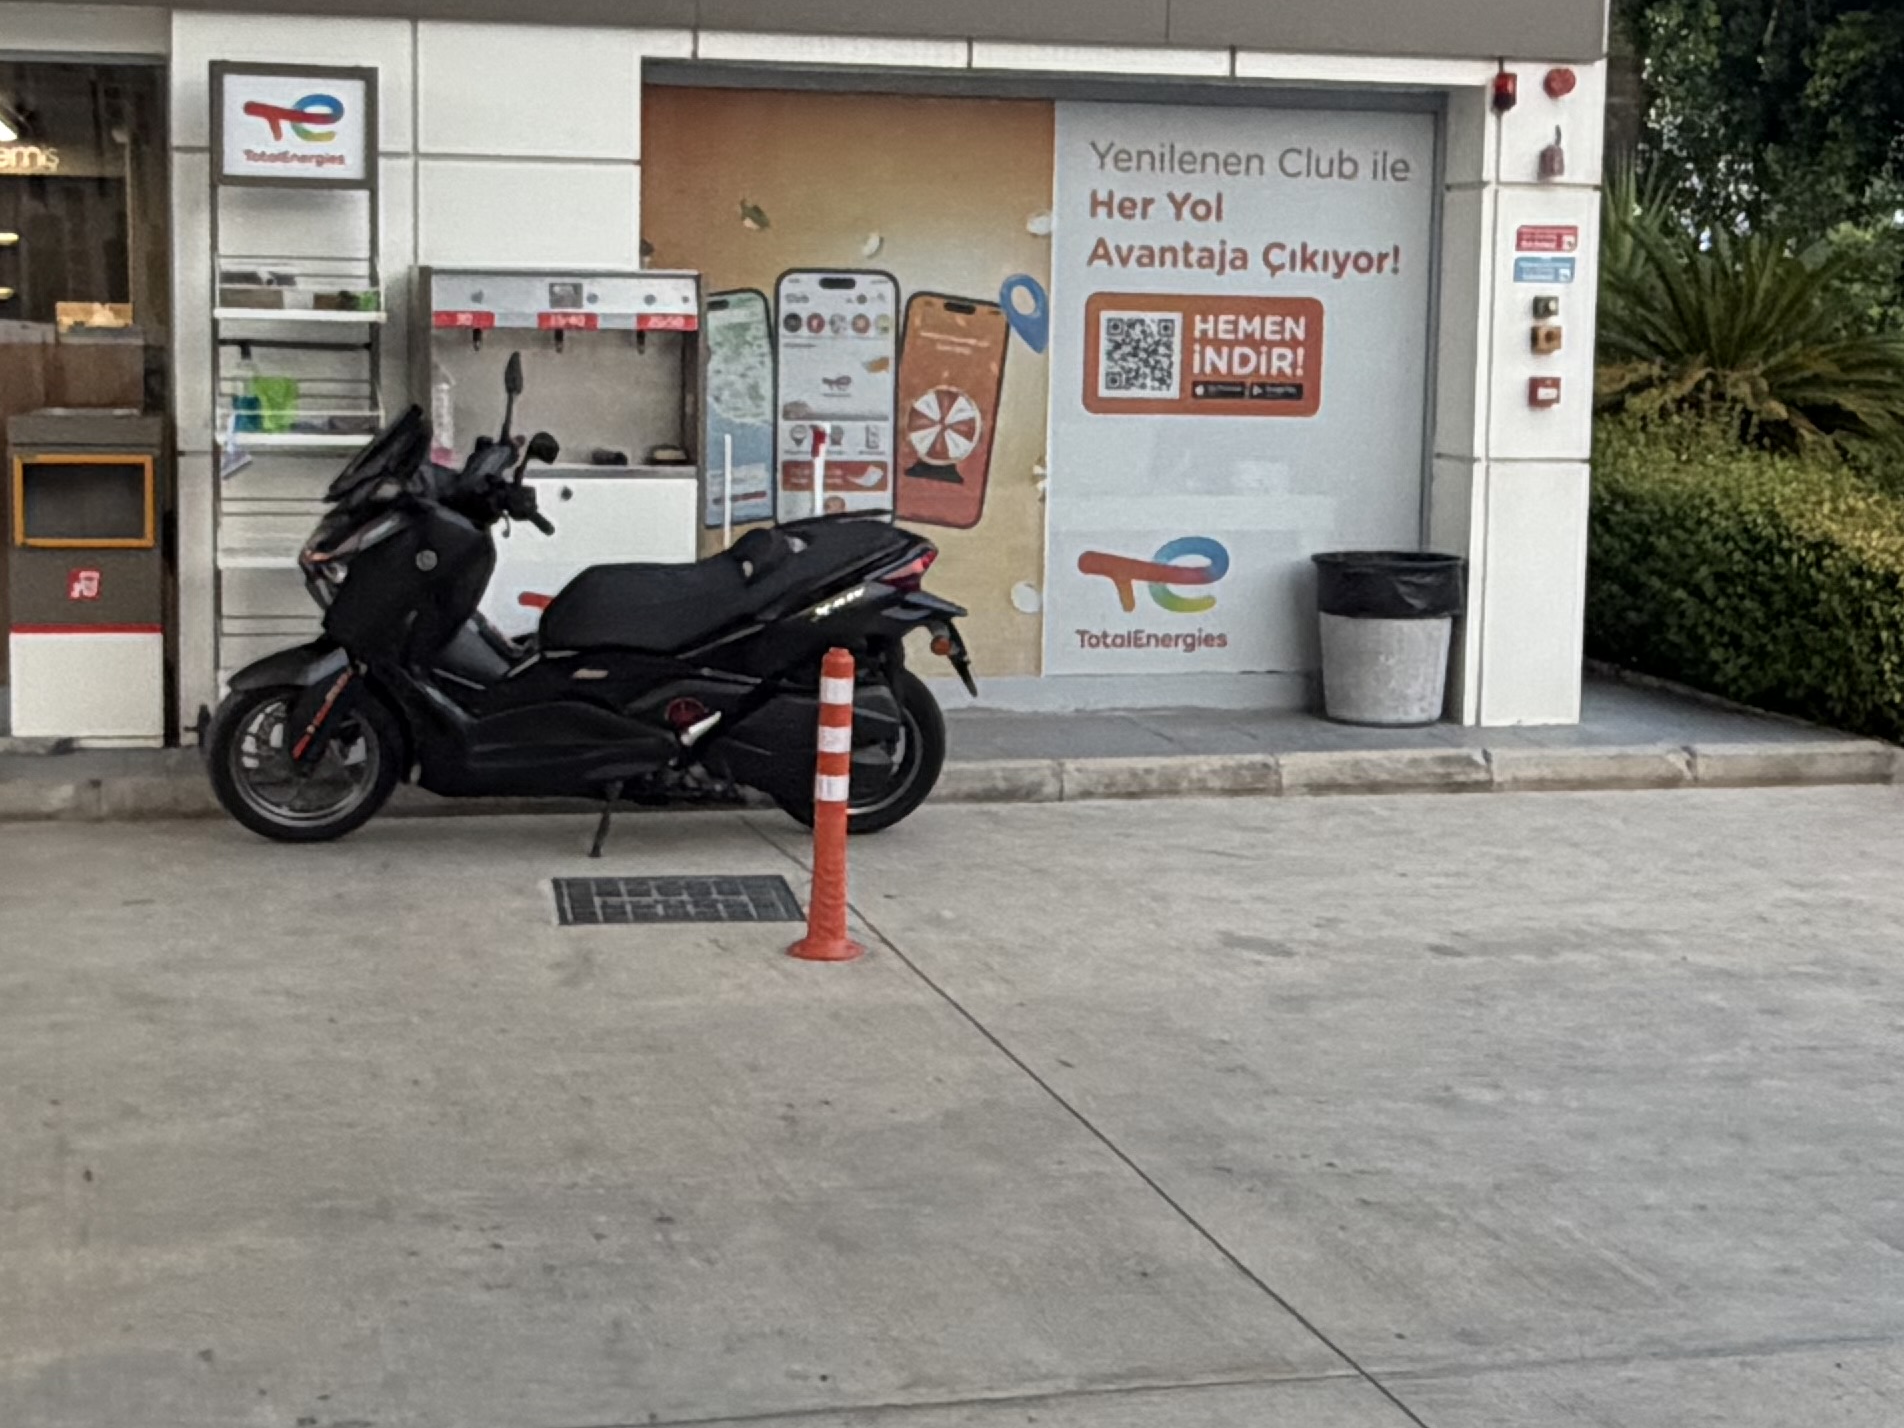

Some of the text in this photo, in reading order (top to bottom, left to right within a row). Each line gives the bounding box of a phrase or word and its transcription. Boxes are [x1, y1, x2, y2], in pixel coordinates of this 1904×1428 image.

[243, 149, 345, 167] TotalEnergies
[1089, 141, 1411, 182] Yenilenen Club ile
[1089, 188, 1224, 223] Her Yol
[1086, 236, 1401, 280] Avantaja Çıkıyor!
[1194, 314, 1306, 341] HEMEN
[1075, 627, 1228, 653] TotalEnergies
